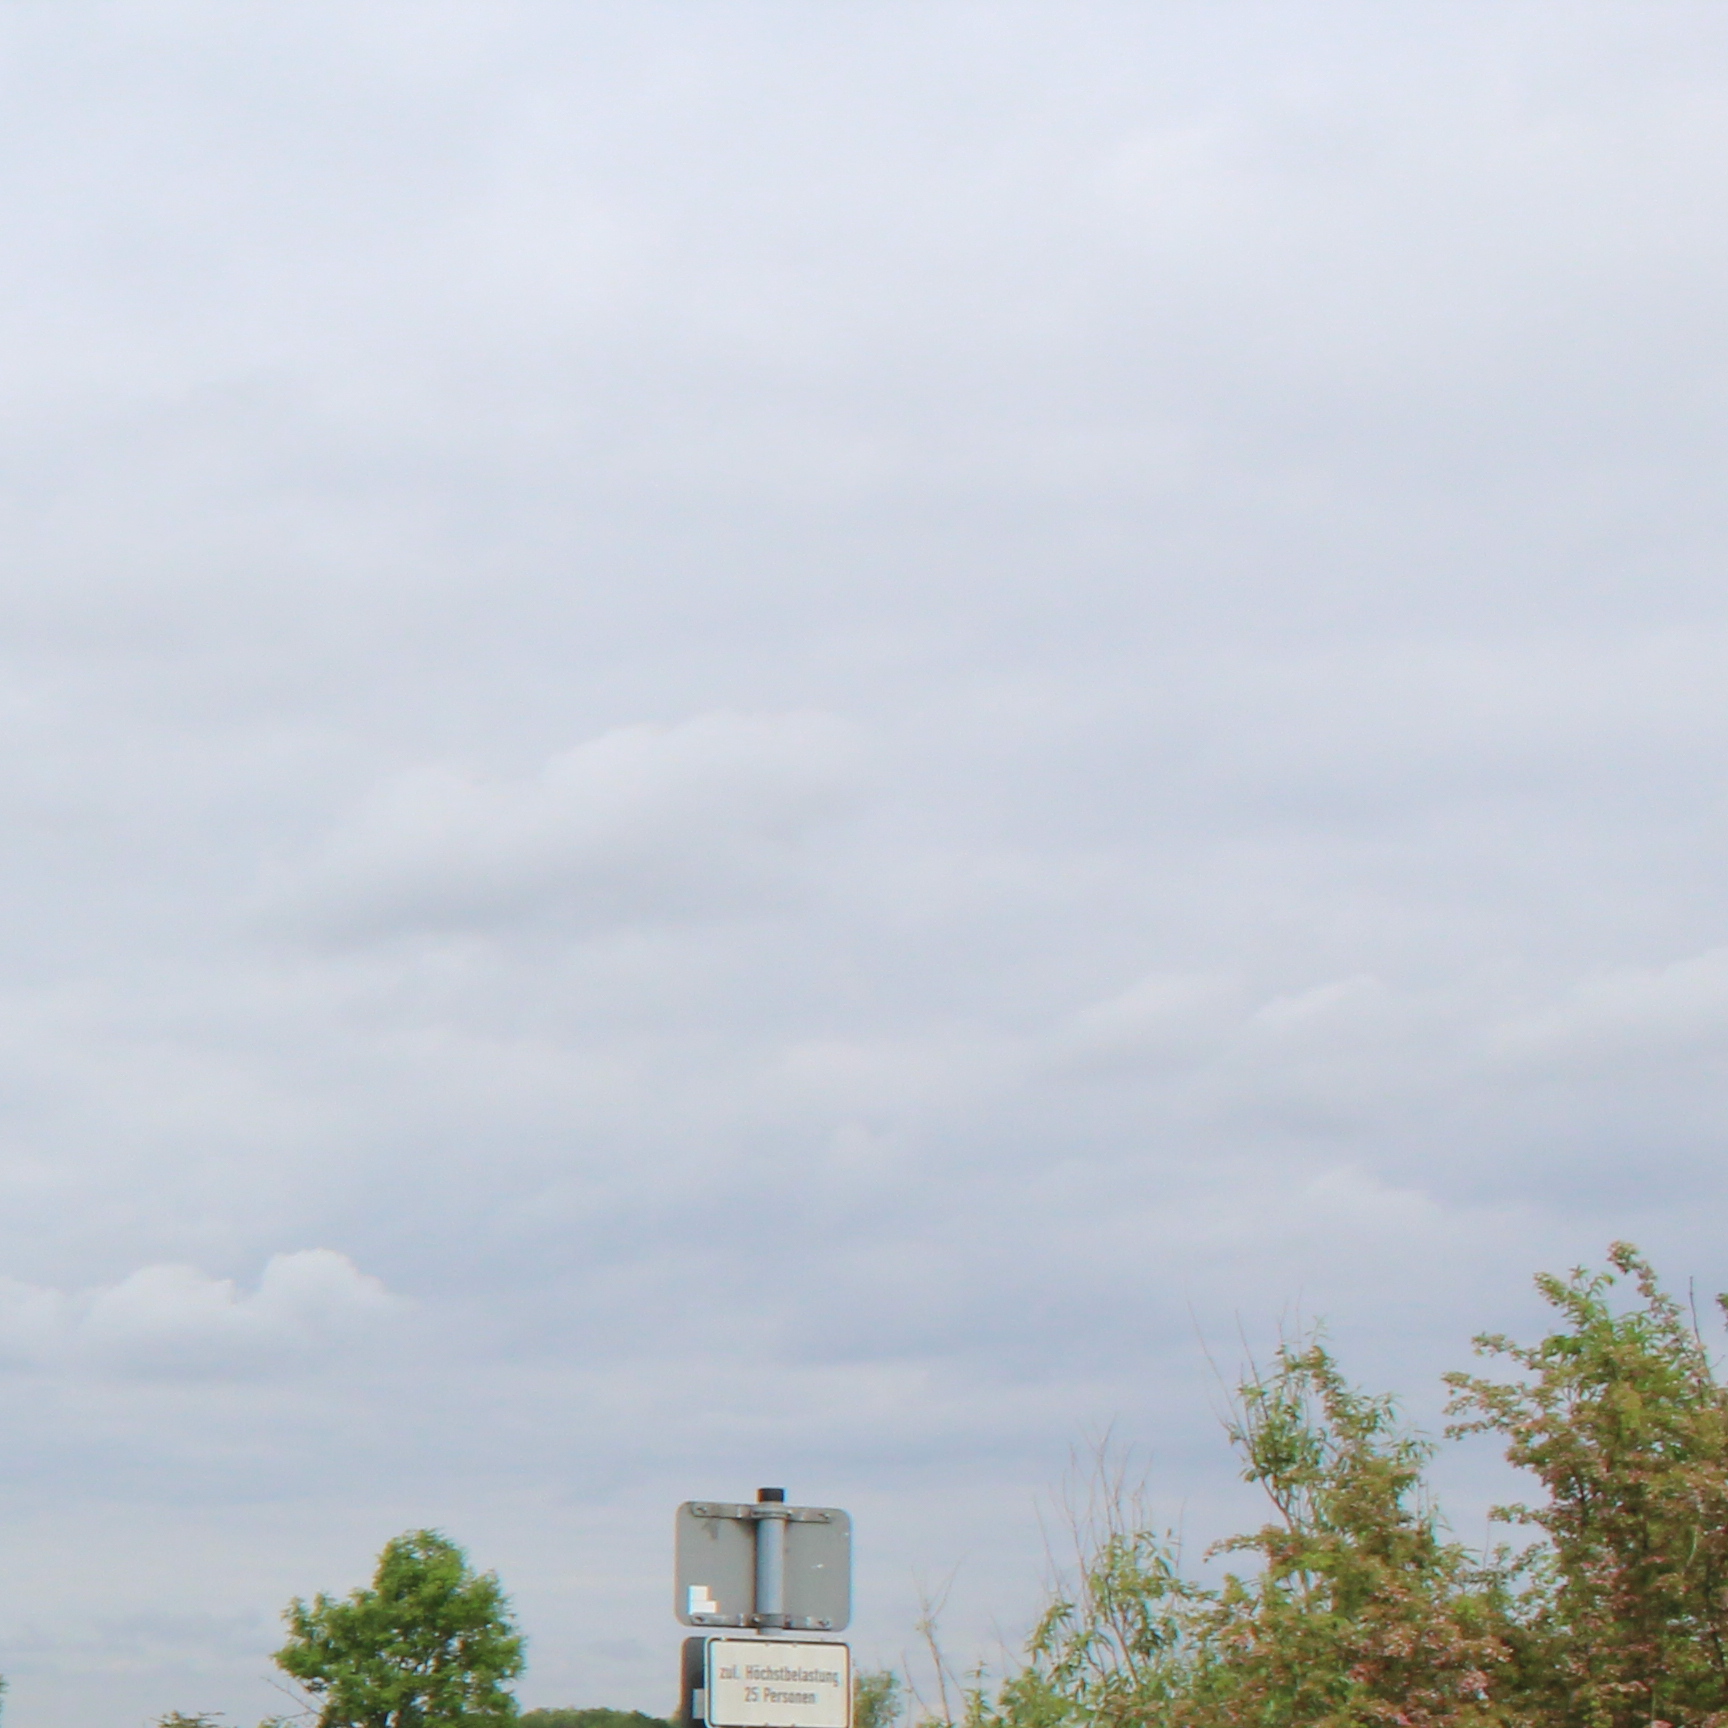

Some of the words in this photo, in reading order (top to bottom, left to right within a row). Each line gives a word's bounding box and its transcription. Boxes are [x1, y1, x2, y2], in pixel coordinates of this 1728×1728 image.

[719, 1664, 740, 1680] zul.
[745, 1664, 839, 1687] Höchstbelastung
[744, 1686, 758, 1703] 25
[763, 1687, 816, 1704] Personen
